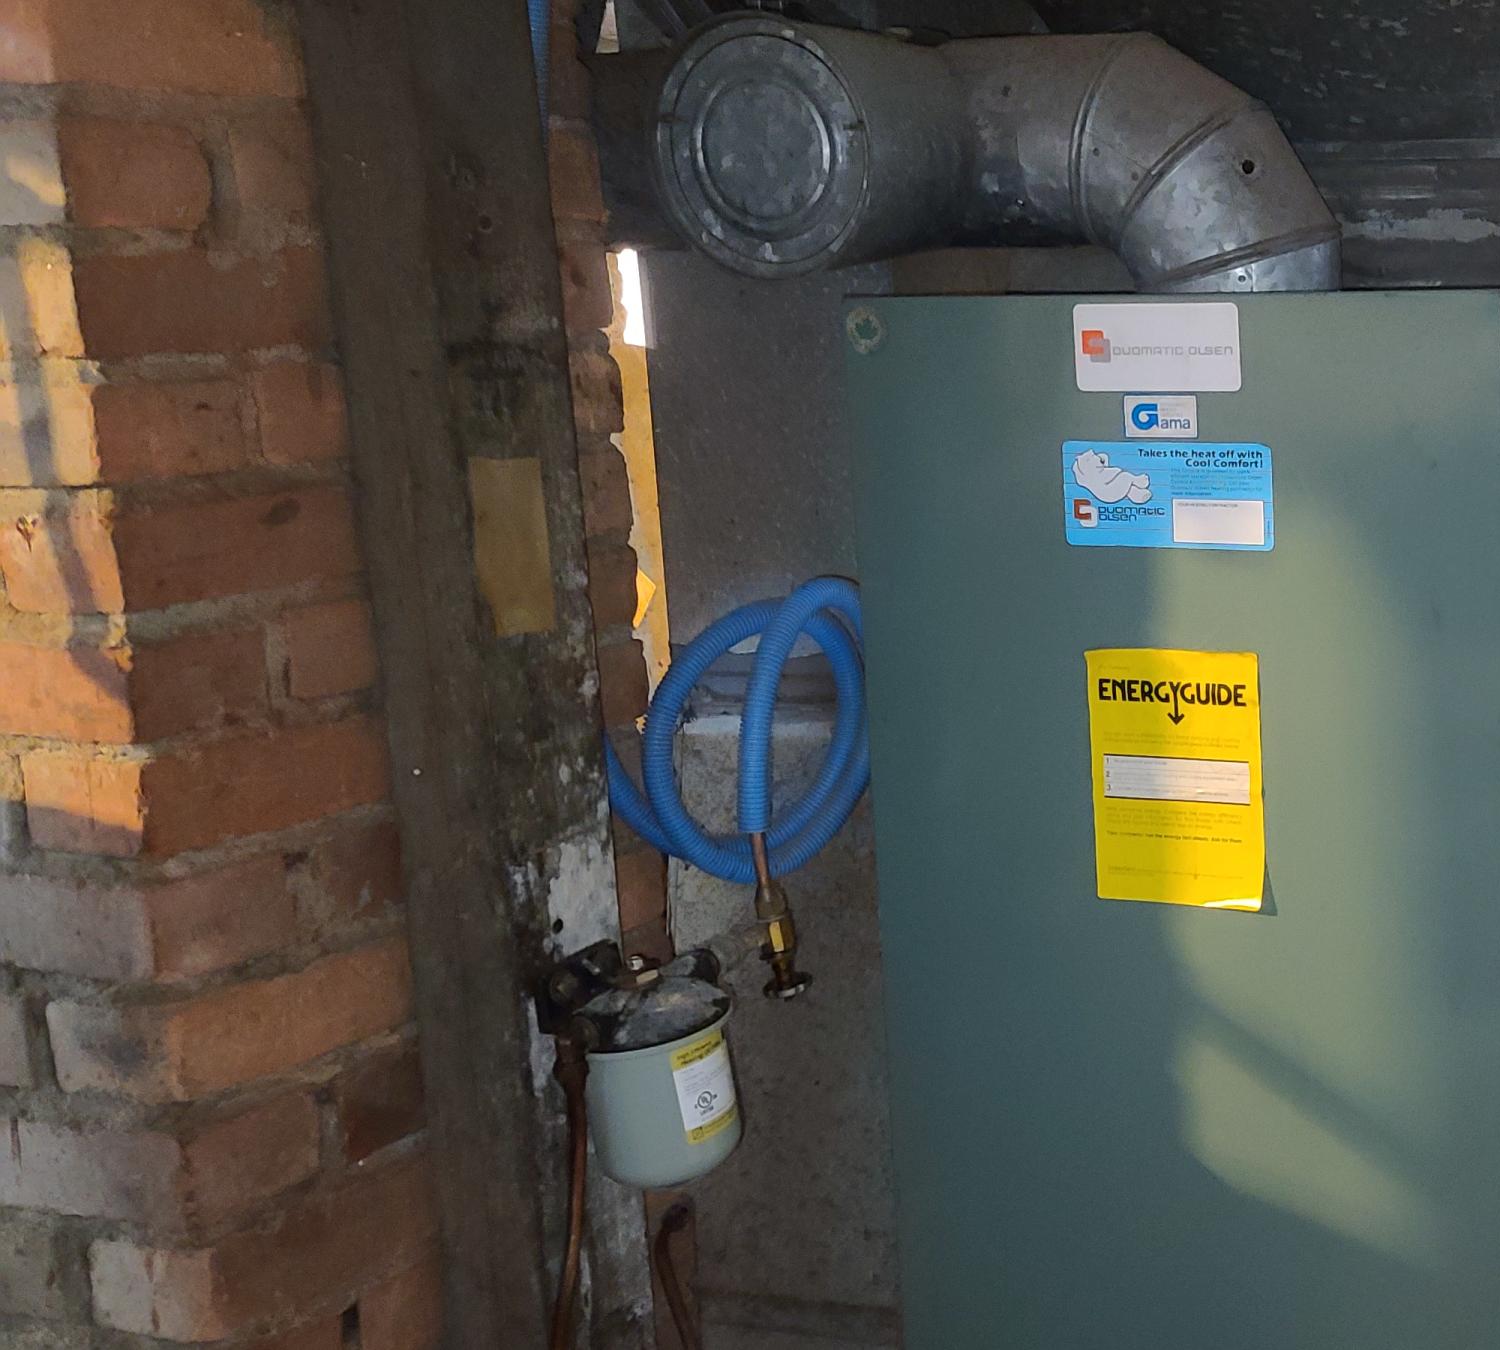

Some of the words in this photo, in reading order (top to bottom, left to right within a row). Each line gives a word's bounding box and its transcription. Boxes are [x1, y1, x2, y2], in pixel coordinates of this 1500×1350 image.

[1112, 345, 1184, 356] DUOMATIC
[1188, 345, 1234, 356] OLSEN
[1138, 449, 1168, 458] Takes
[1170, 449, 1188, 458] the
[1191, 449, 1216, 458] heat
[1218, 450, 1235, 459] off
[1237, 450, 1263, 459] with
[1185, 458, 1211, 467] Cool
[1213, 459, 1263, 468] Comfort!
[1098, 678, 1247, 707] ENERGYGUIDE
